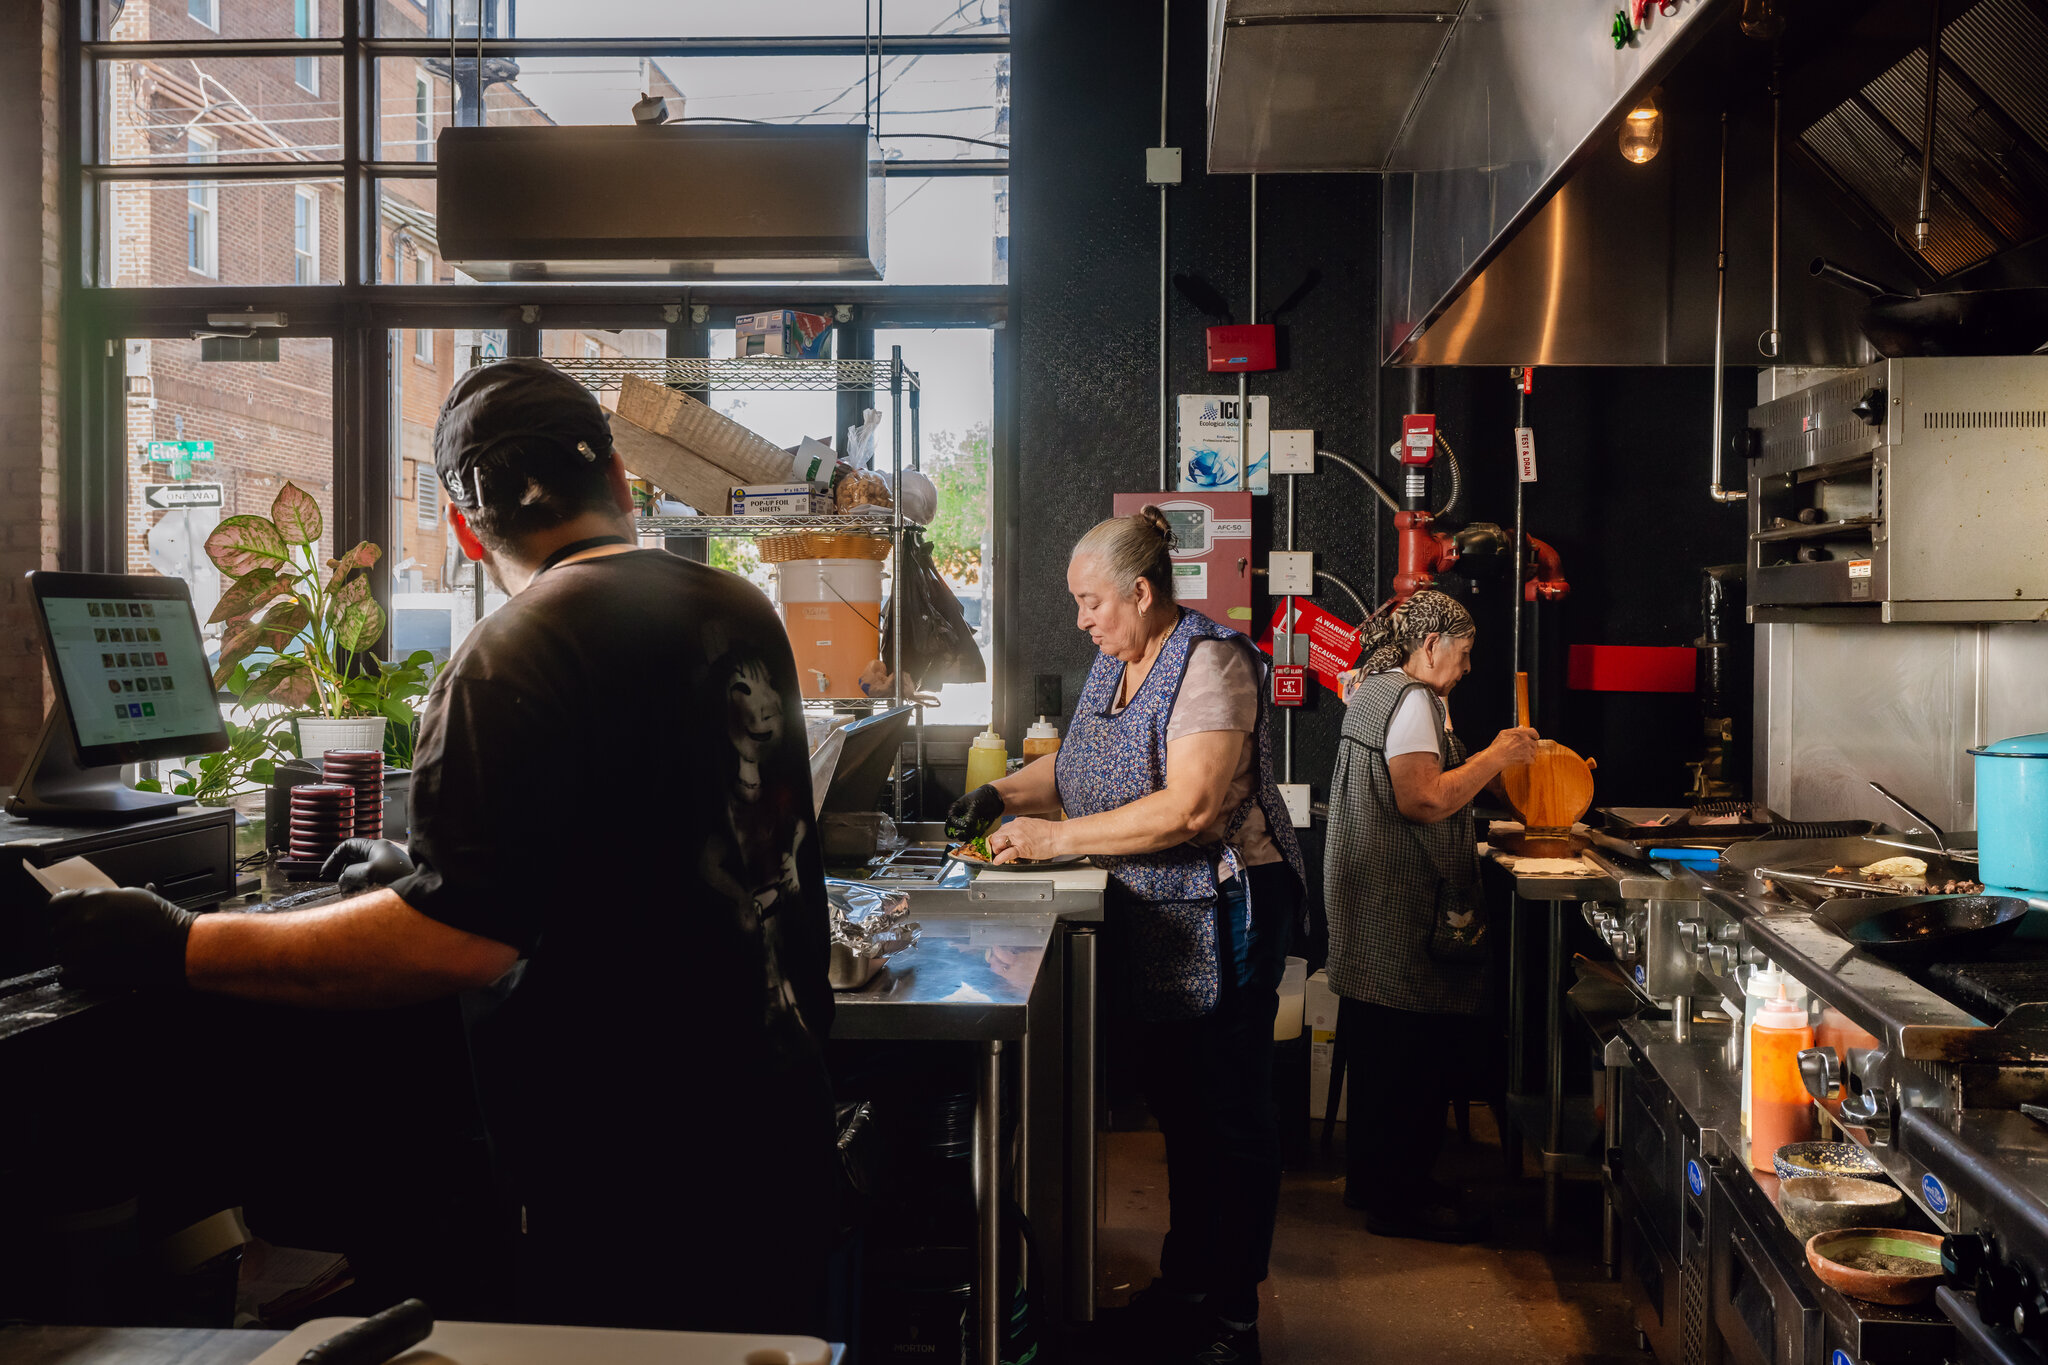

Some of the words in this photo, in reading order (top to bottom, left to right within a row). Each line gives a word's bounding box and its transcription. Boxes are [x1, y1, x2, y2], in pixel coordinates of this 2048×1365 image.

[1220, 401, 1252, 420] ICON
[1521, 433, 1530, 449] TEST
[151, 443, 178, 460] Elm
[1522, 457, 1531, 476] DRAIN
[166, 493, 187, 501] ONE
[192, 492, 215, 501] WAY
[759, 505, 781, 513] SHEETS
[1310, 641, 1349, 668] RECAUCION
[894, 1343, 936, 1353] MORTON
